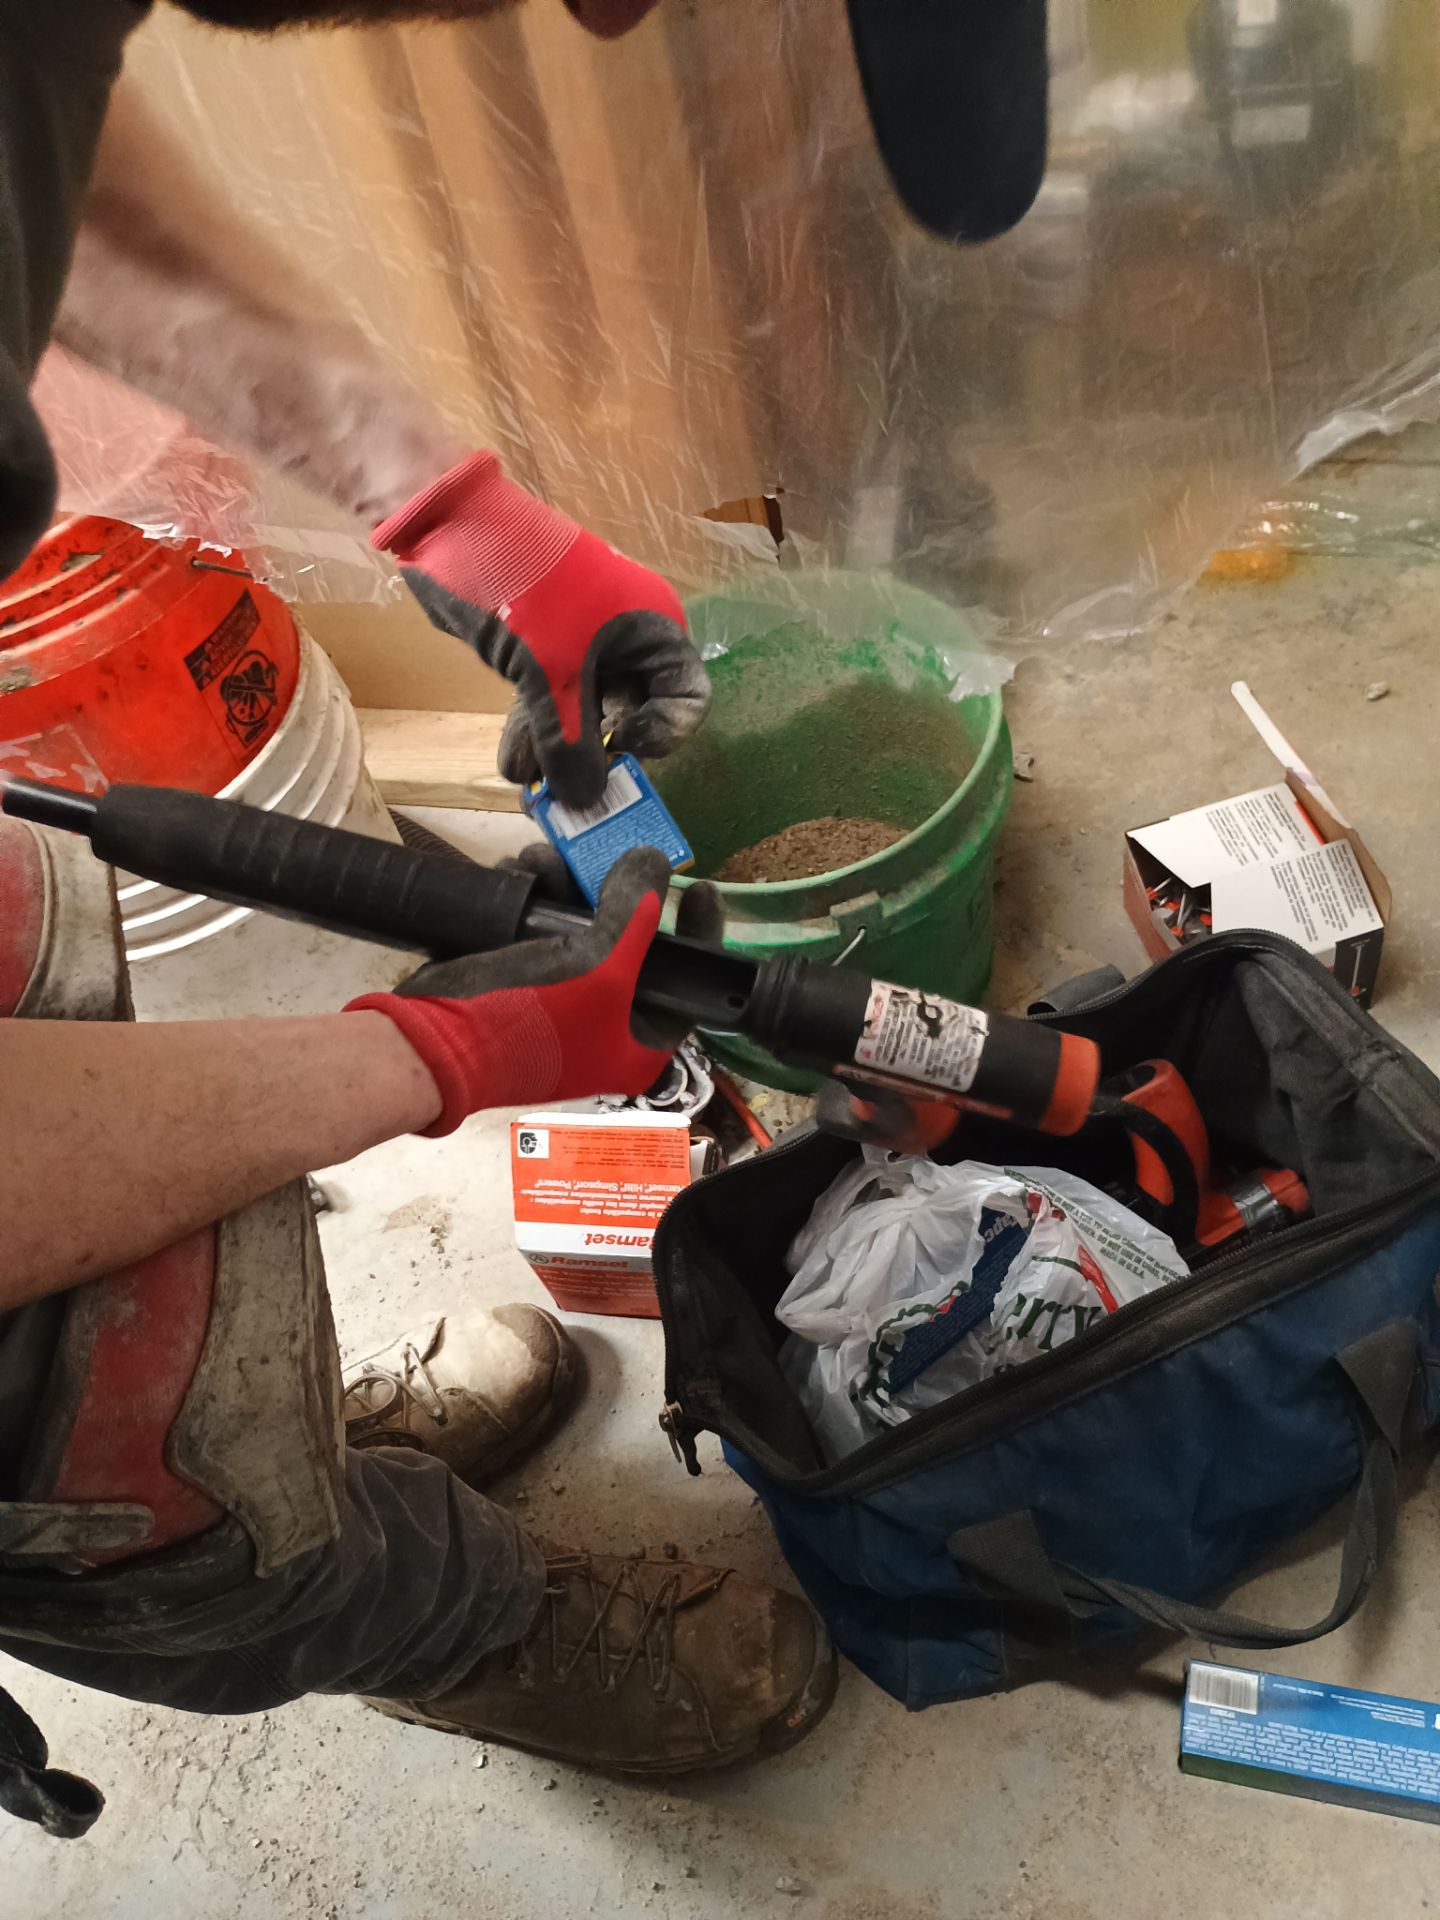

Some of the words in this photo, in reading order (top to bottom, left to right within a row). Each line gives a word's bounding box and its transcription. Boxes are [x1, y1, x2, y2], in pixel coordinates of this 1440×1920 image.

[1060, 1200, 1076, 1213] NOT
[1097, 1234, 1108, 1245] DO
[1106, 1240, 1122, 1252] NOT
[1120, 1247, 1135, 1261] USE
[1133, 1255, 1143, 1265] IN
[551, 1257, 630, 1268] Ramset
[1100, 1246, 1118, 1262] MADE
[1118, 1257, 1127, 1267] IN
[1125, 1261, 1145, 1279] U.S.A.
